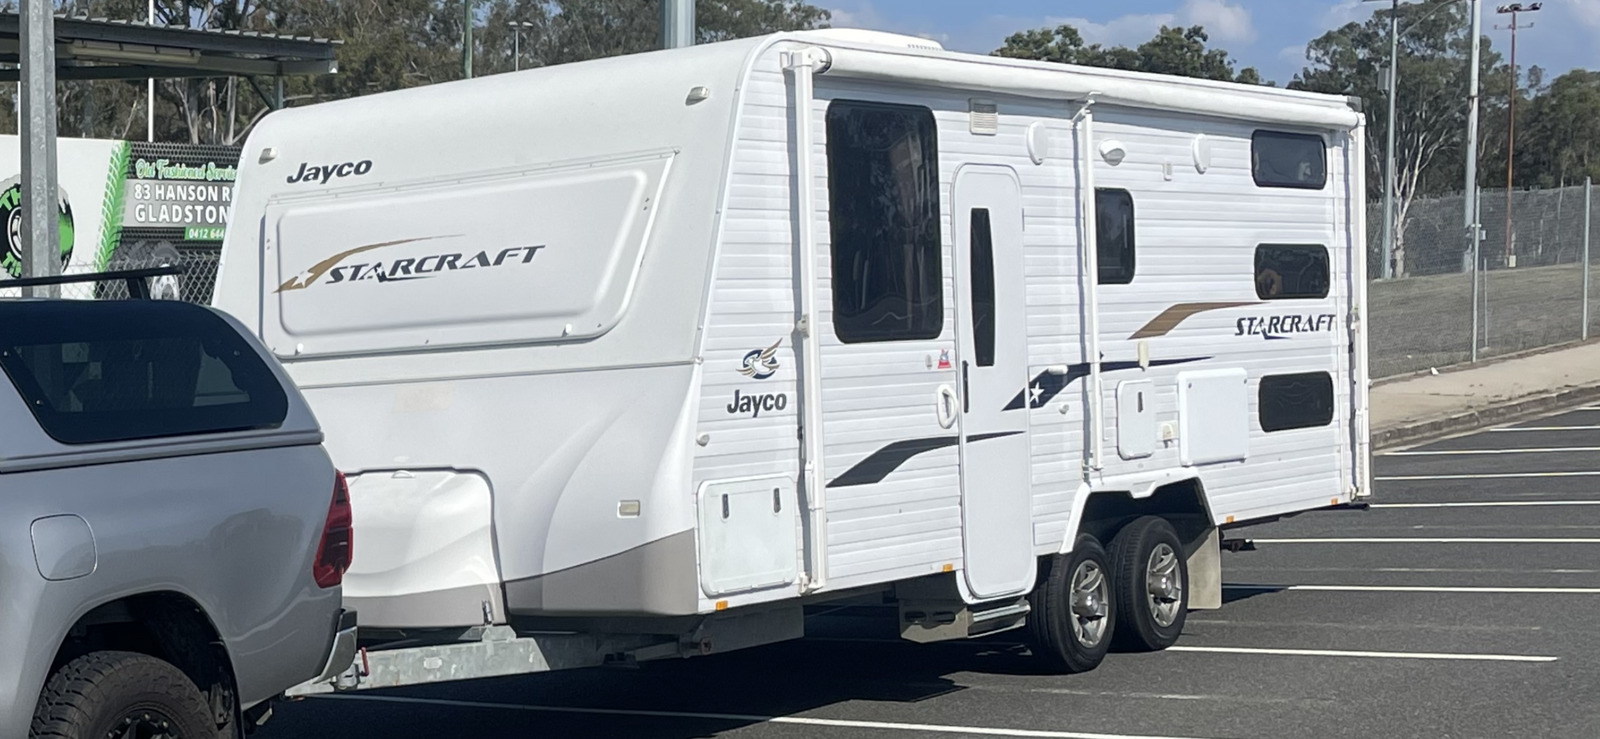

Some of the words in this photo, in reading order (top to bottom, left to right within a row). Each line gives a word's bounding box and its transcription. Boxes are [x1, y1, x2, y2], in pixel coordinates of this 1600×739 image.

[135, 158, 155, 179] Old
[156, 159, 207, 180] Fashioned
[286, 160, 373, 184] Jayco
[134, 184, 151, 200] 83
[155, 184, 218, 202] HANSON
[222, 186, 233, 202] R
[188, 228, 208, 239] 0412
[325, 245, 546, 283] STARCRAFT
[1234, 314, 1336, 339] STARCRAFT
[726, 389, 787, 418] Jayco
